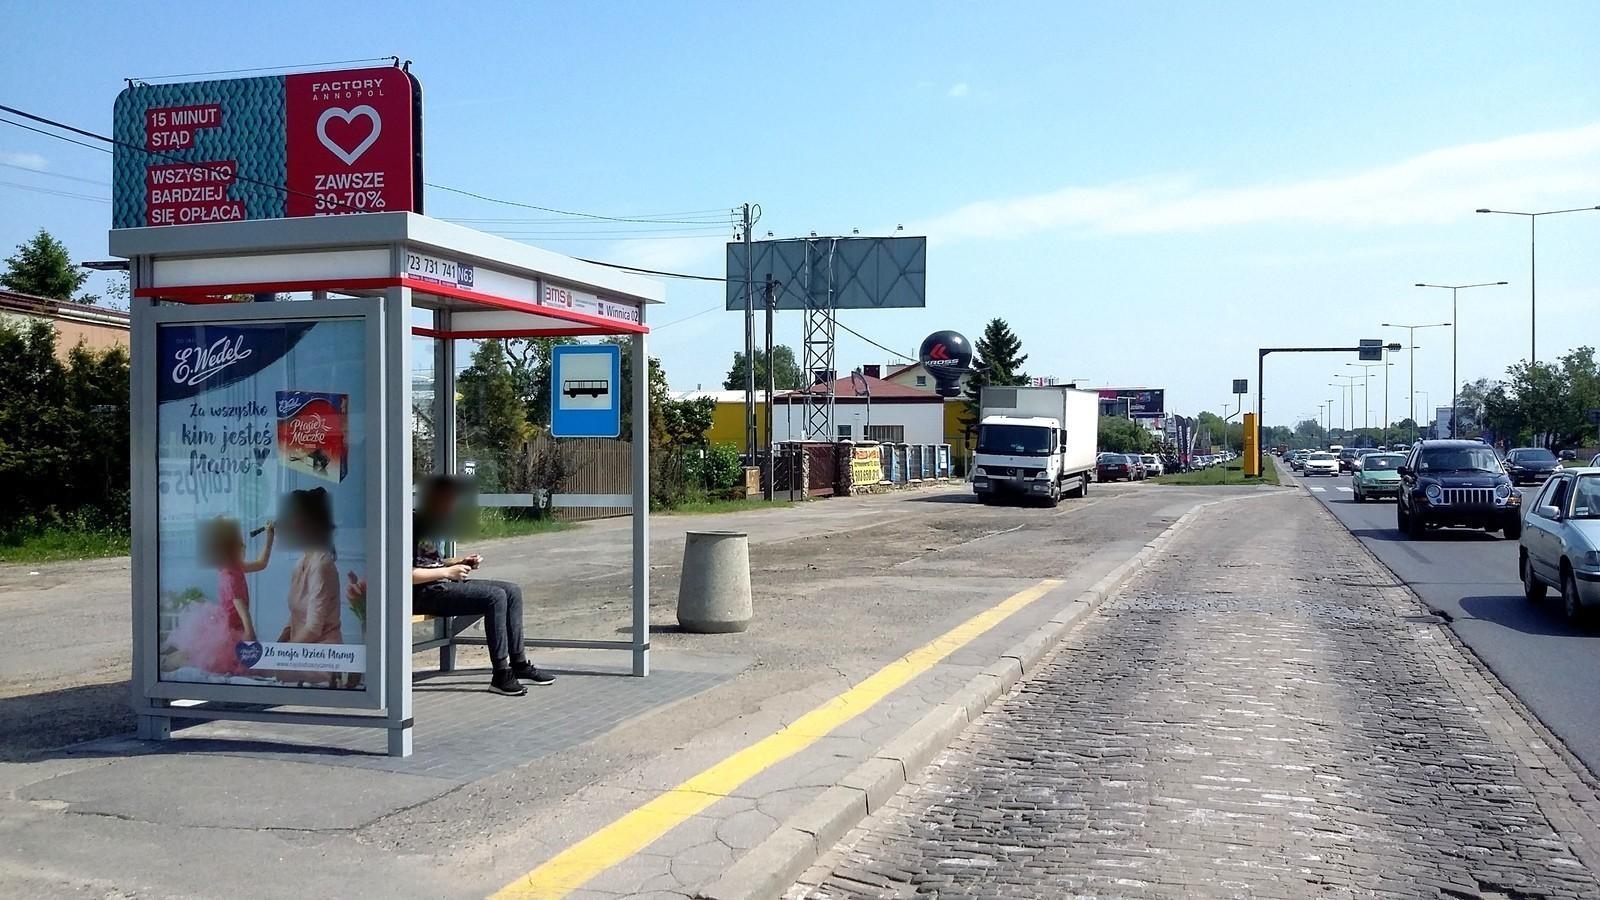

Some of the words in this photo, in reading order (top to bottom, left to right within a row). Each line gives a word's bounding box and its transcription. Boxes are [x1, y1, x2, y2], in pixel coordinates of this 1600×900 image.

[312, 78, 384, 93] FACTORY
[312, 90, 385, 101] ANNOPOL
[151, 113, 167, 127] 15
[171, 109, 217, 126] MINUT
[152, 131, 190, 150] STĄD
[152, 166, 232, 185] WSZYSTKO
[315, 172, 385, 190] ZAWSZE
[152, 187, 223, 204] BARDZIEJ
[152, 208, 175, 226] SIĘ
[179, 204, 241, 222] OPŁACA
[424, 258, 438, 275] 731
[442, 263, 456, 278] 741
[458, 266, 473, 283] N63
[606, 304, 631, 321] Winnica
[172, 335, 252, 386] E.Wedel
[925, 358, 959, 366] KROSS
[190, 403, 205, 418] Za
[211, 400, 268, 422] wszystko
[181, 423, 216, 446] kim
[221, 422, 273, 454] jesteś
[289, 430, 327, 446] Mleczko
[264, 647, 275, 657] 26
[277, 648, 299, 661] maja
[302, 647, 326, 659] Dzień
[328, 648, 355, 663] Mamy
